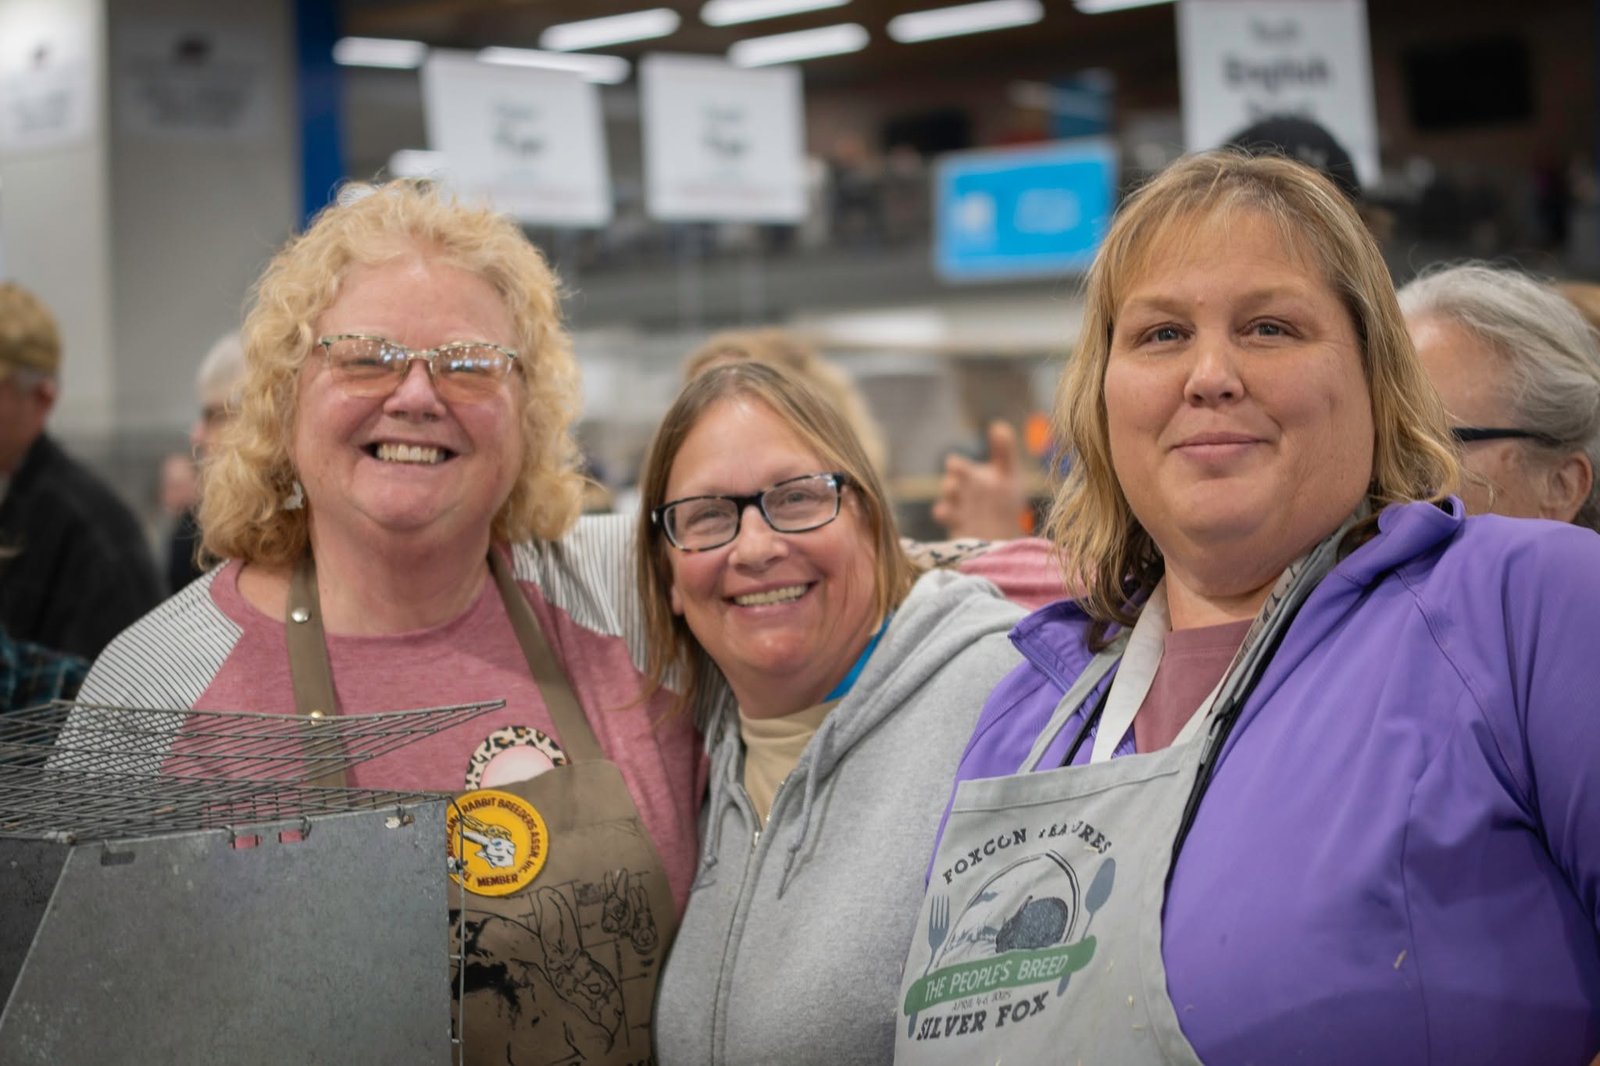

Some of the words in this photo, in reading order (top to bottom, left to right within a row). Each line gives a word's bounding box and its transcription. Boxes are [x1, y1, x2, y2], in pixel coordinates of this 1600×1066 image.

[461, 797, 496, 814] RABBIT
[497, 799, 537, 831] BREEDERS
[943, 828, 1026, 885] FOXCON
[1038, 820, 1112, 854] EAURES
[476, 873, 519, 887] MEMBER
[925, 976, 947, 1002] THE
[950, 960, 1012, 994] PEOPLE'S
[1017, 954, 1069, 981] BREED
[917, 1010, 987, 1041] SILVER
[995, 991, 1049, 1029] FOX
